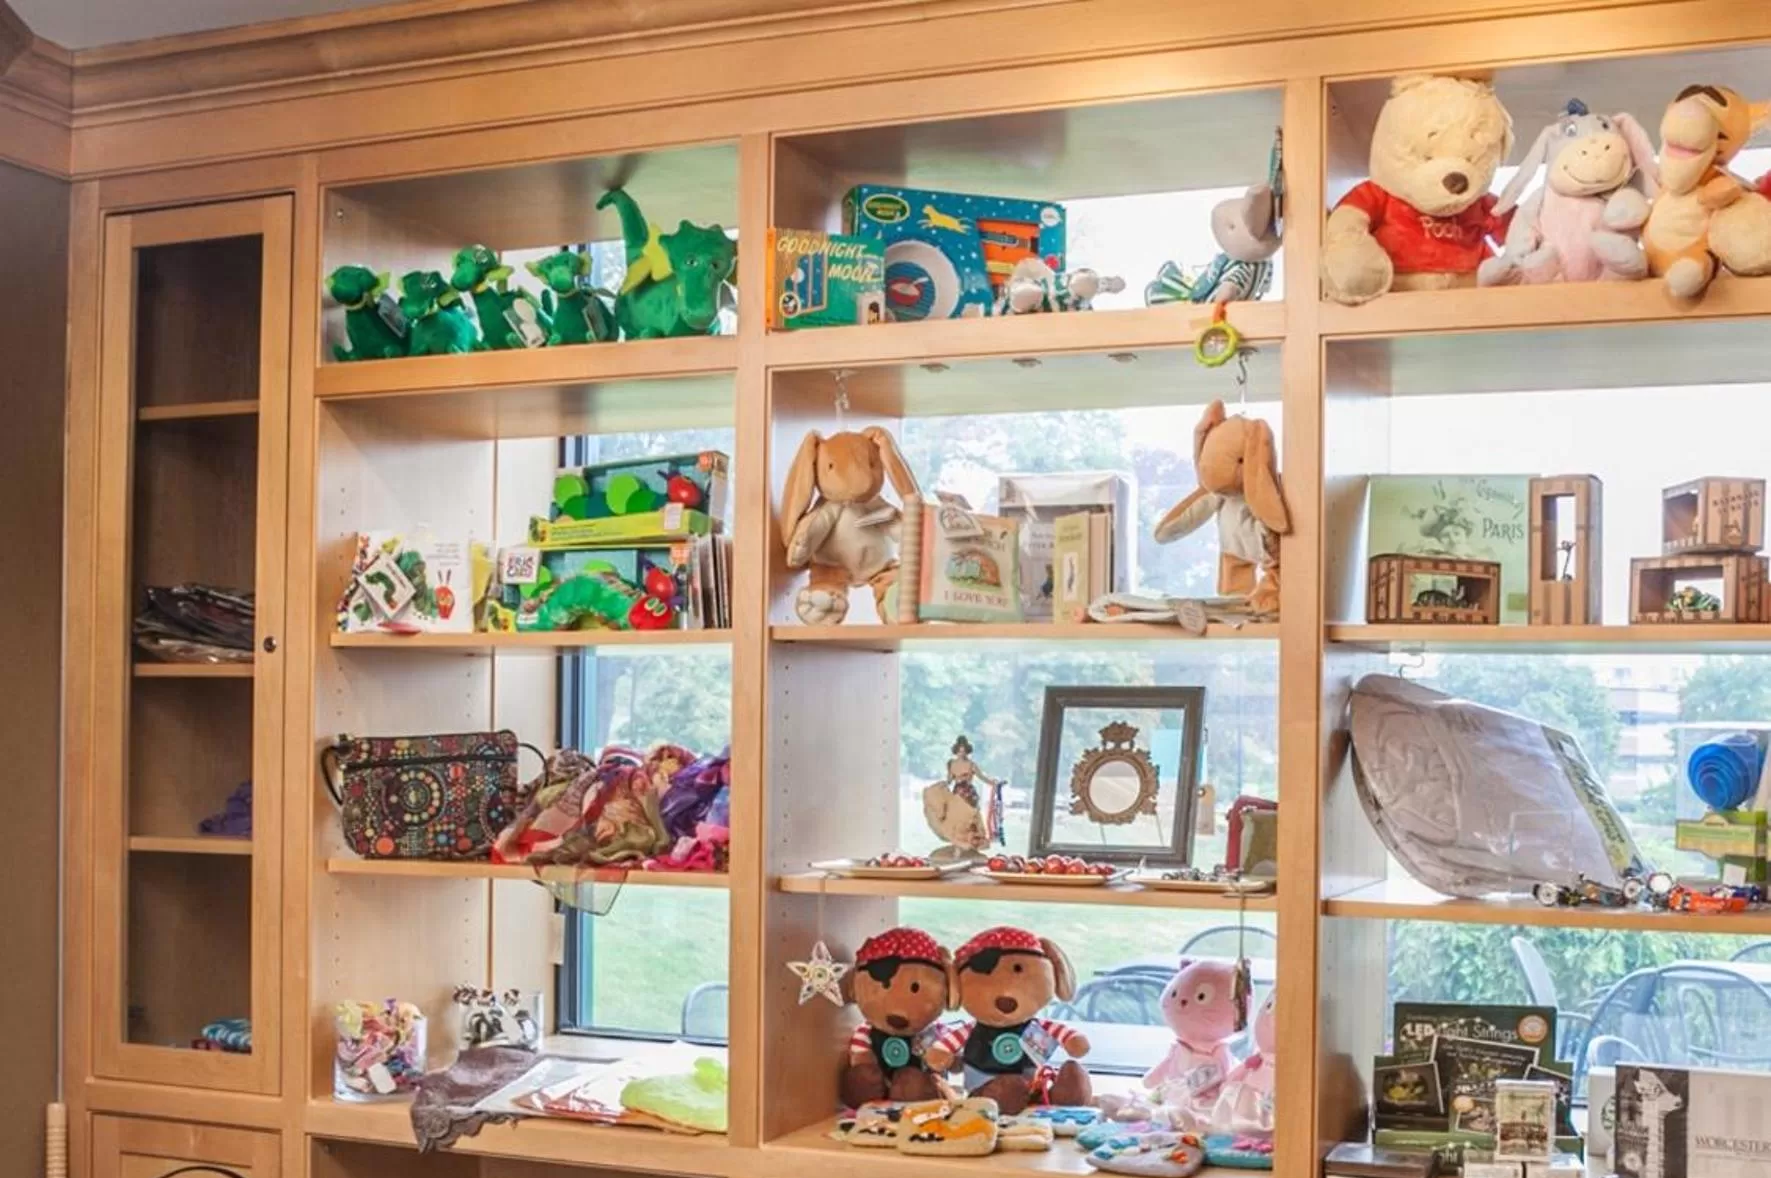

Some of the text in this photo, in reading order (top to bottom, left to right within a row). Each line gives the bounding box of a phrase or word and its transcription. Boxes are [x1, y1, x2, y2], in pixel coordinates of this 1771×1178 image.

[1419, 215, 1462, 241] Pooh
[776, 236, 868, 258] GOODNIGHT
[1482, 516, 1524, 545] PARIS
[1406, 1022, 1518, 1042] LED Light Strings
